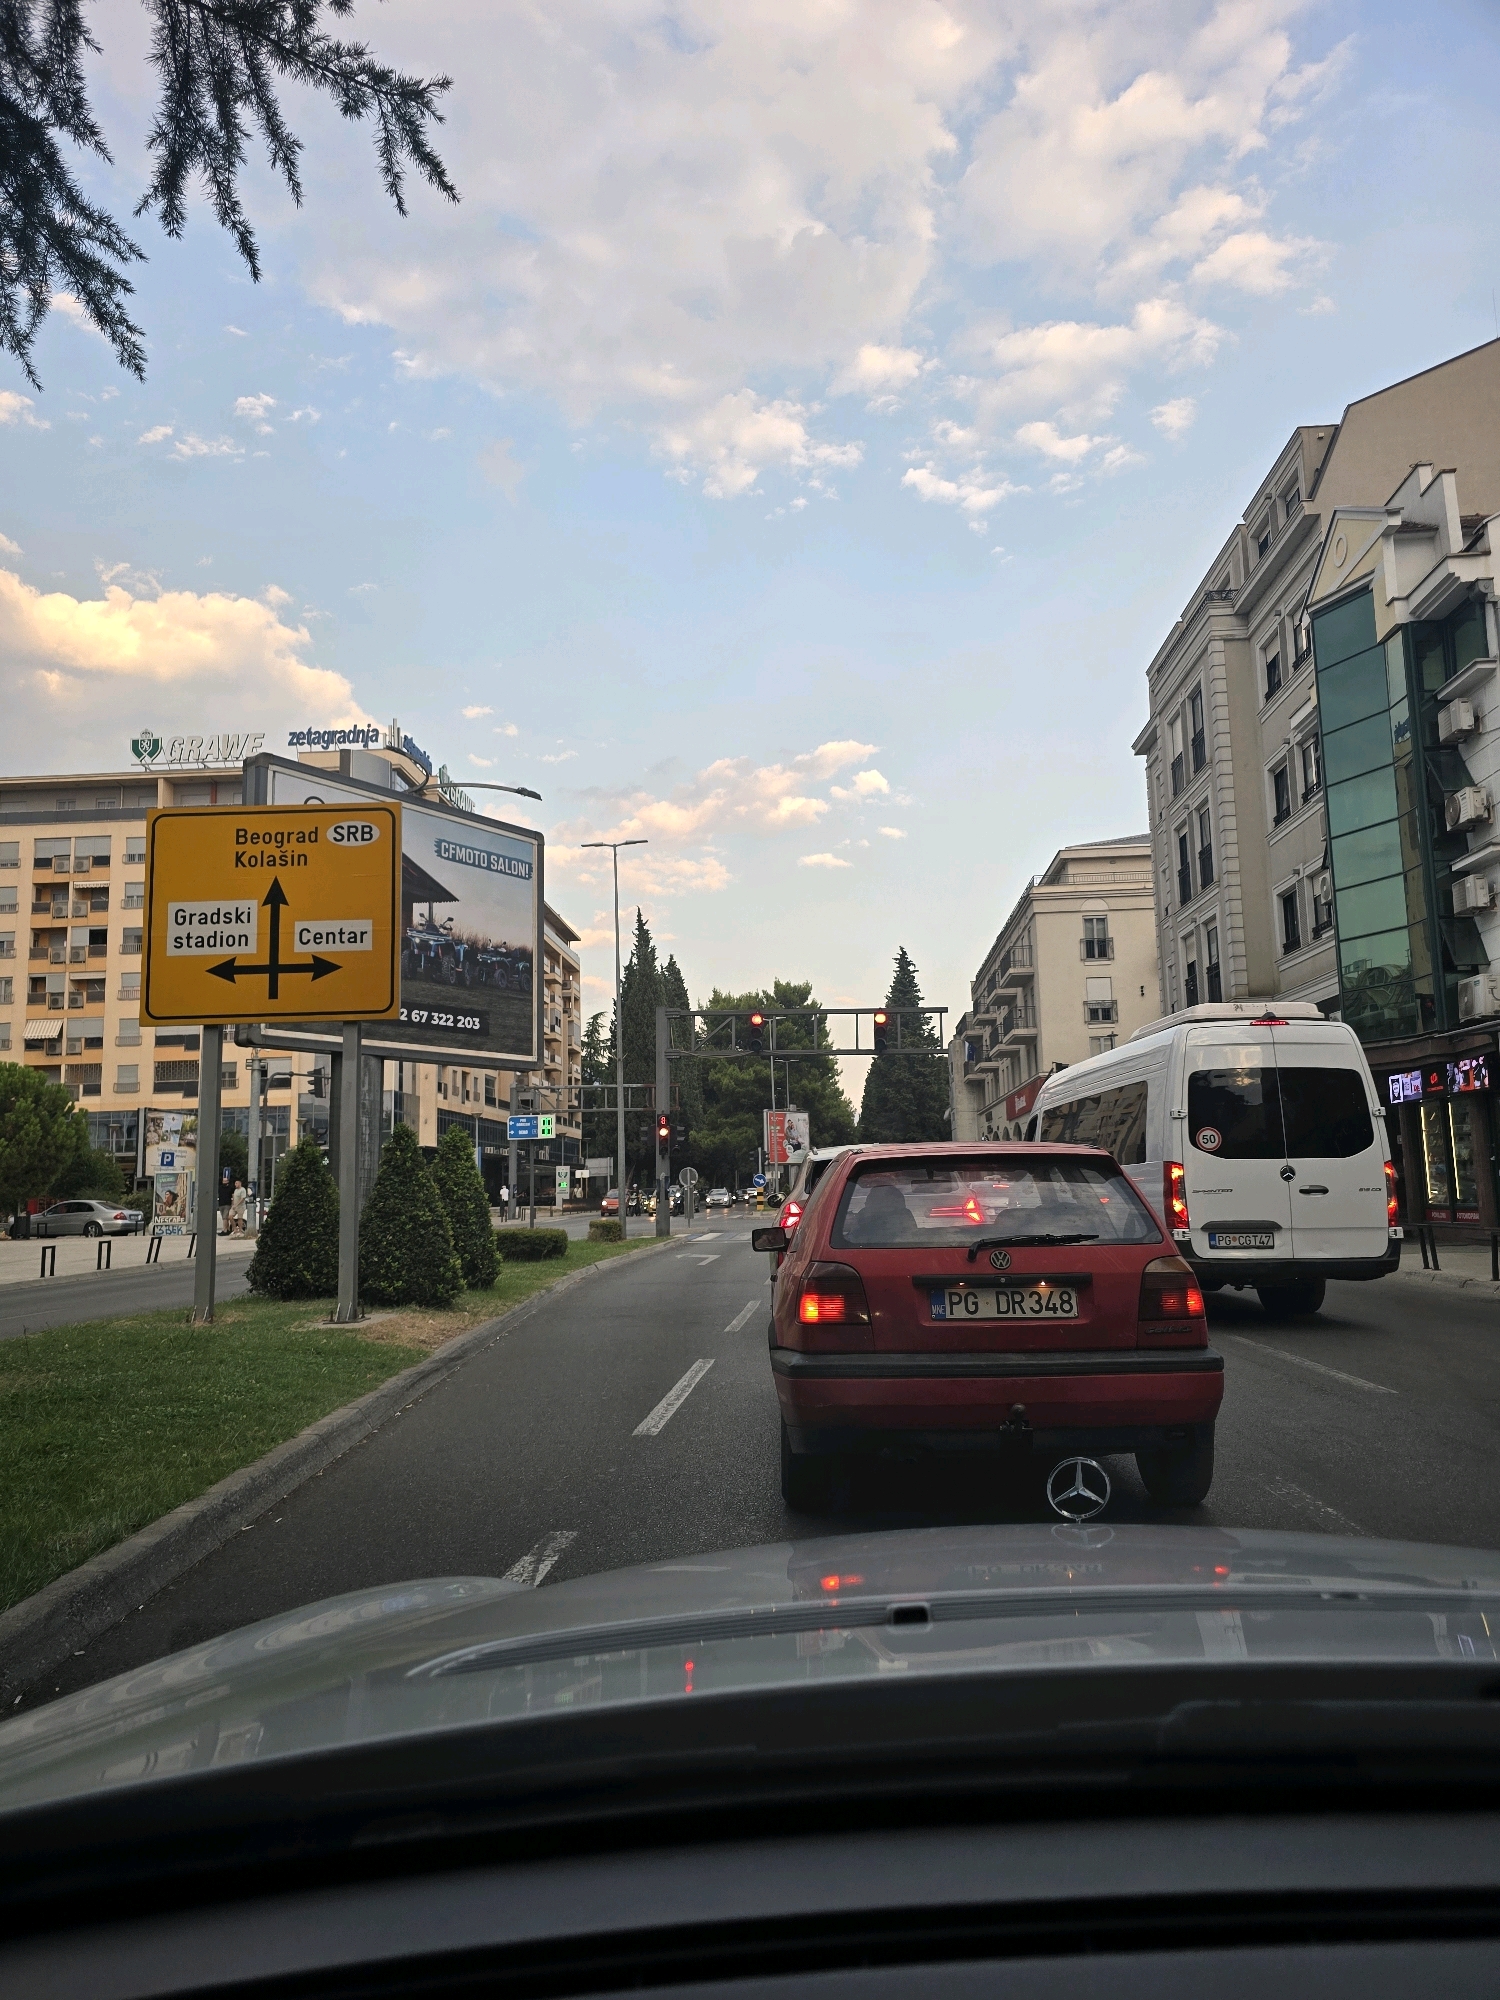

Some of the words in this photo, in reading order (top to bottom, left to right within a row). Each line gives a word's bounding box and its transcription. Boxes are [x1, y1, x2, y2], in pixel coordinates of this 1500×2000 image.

[288, 724, 380, 750] zetagradnja
[164, 733, 265, 762] GRAWE
[235, 826, 319, 849] Beograd
[332, 824, 374, 843] SRB
[235, 850, 308, 868] Kolašin
[441, 842, 488, 868] CFMOTO
[490, 855, 529, 878] SALON!
[174, 906, 251, 926] Gradski
[173, 930, 249, 949] stadion
[298, 927, 368, 945] Centar
[411, 1009, 428, 1023] 67
[431, 1012, 454, 1027] 322
[456, 1015, 480, 1030] 203
[1202, 1134, 1216, 1145] 50
[1218, 1235, 1231, 1245] PG
[1238, 1235, 1271, 1246] CGT47
[948, 1291, 979, 1316] PG
[995, 1290, 1074, 1315] DR348
